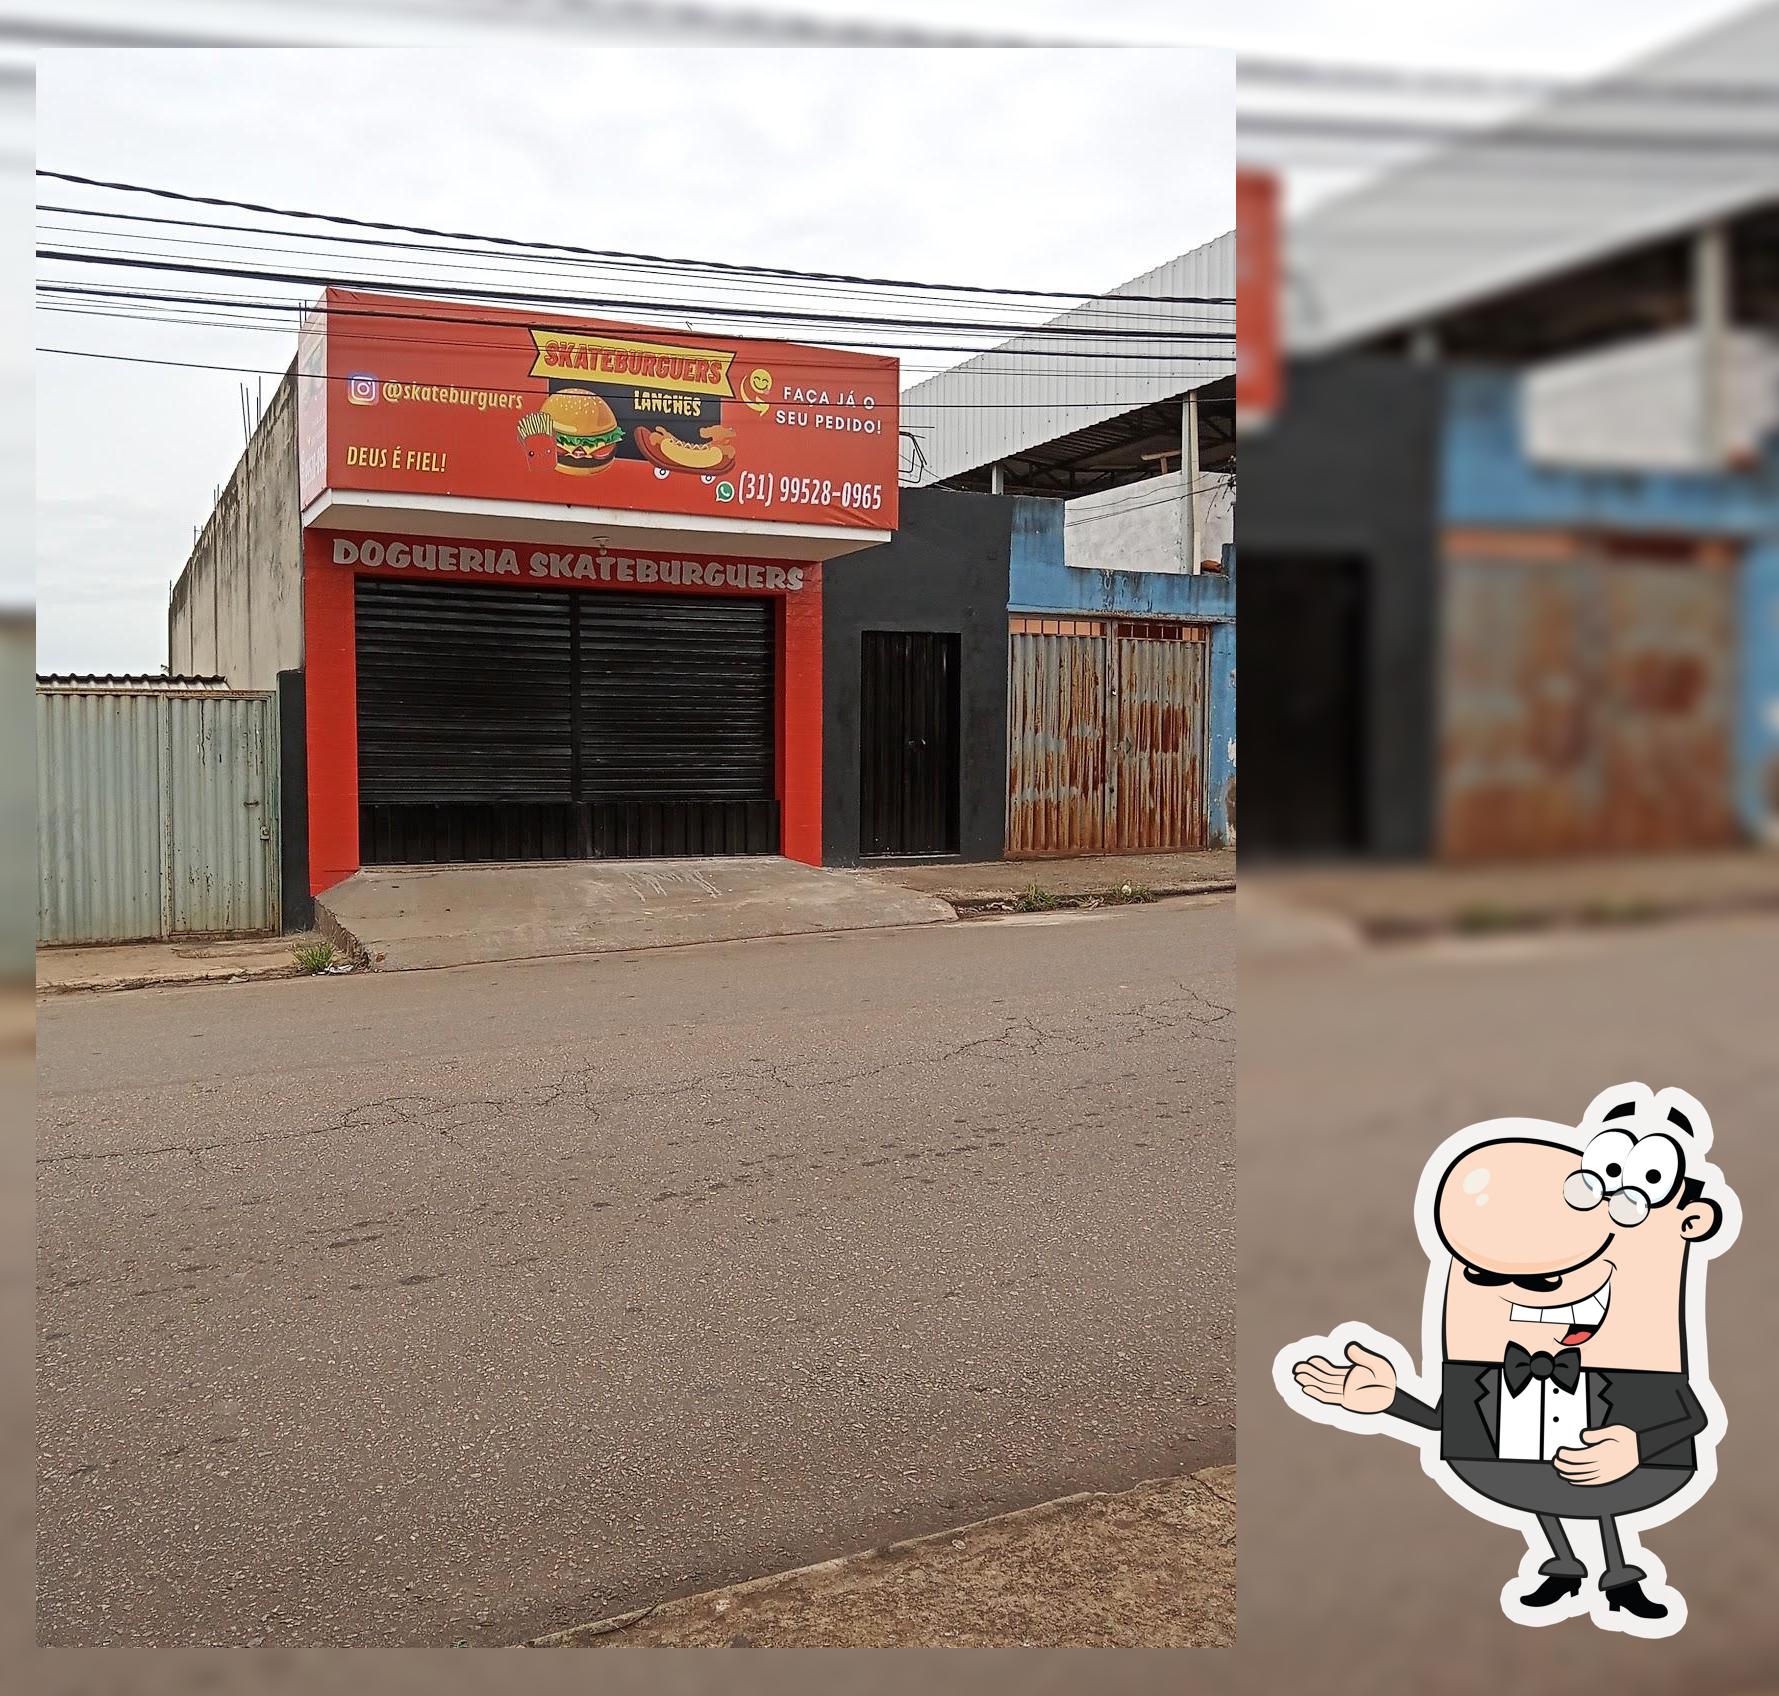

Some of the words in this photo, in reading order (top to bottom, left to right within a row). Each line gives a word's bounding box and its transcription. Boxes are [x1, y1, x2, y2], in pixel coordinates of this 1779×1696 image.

[543, 339, 724, 386] SKATEBURGUERS
[382, 379, 524, 411] @skateburguers
[634, 389, 702, 417] LANCHES
[783, 386, 830, 408] FAÇA
[836, 390, 856, 408] JÁ
[863, 396, 875, 410] O
[775, 409, 809, 427] SEU
[815, 413, 882, 435] PEDIDO!
[346, 445, 388, 468] DEUS
[392, 445, 402, 470] É
[406, 450, 448, 473] FIEL!
[738, 470, 774, 507] (31)
[779, 476, 882, 510] 99528-0965
[333, 538, 521, 576] DOGUERIA
[529, 552, 805, 591] SKATEBURGUERS
